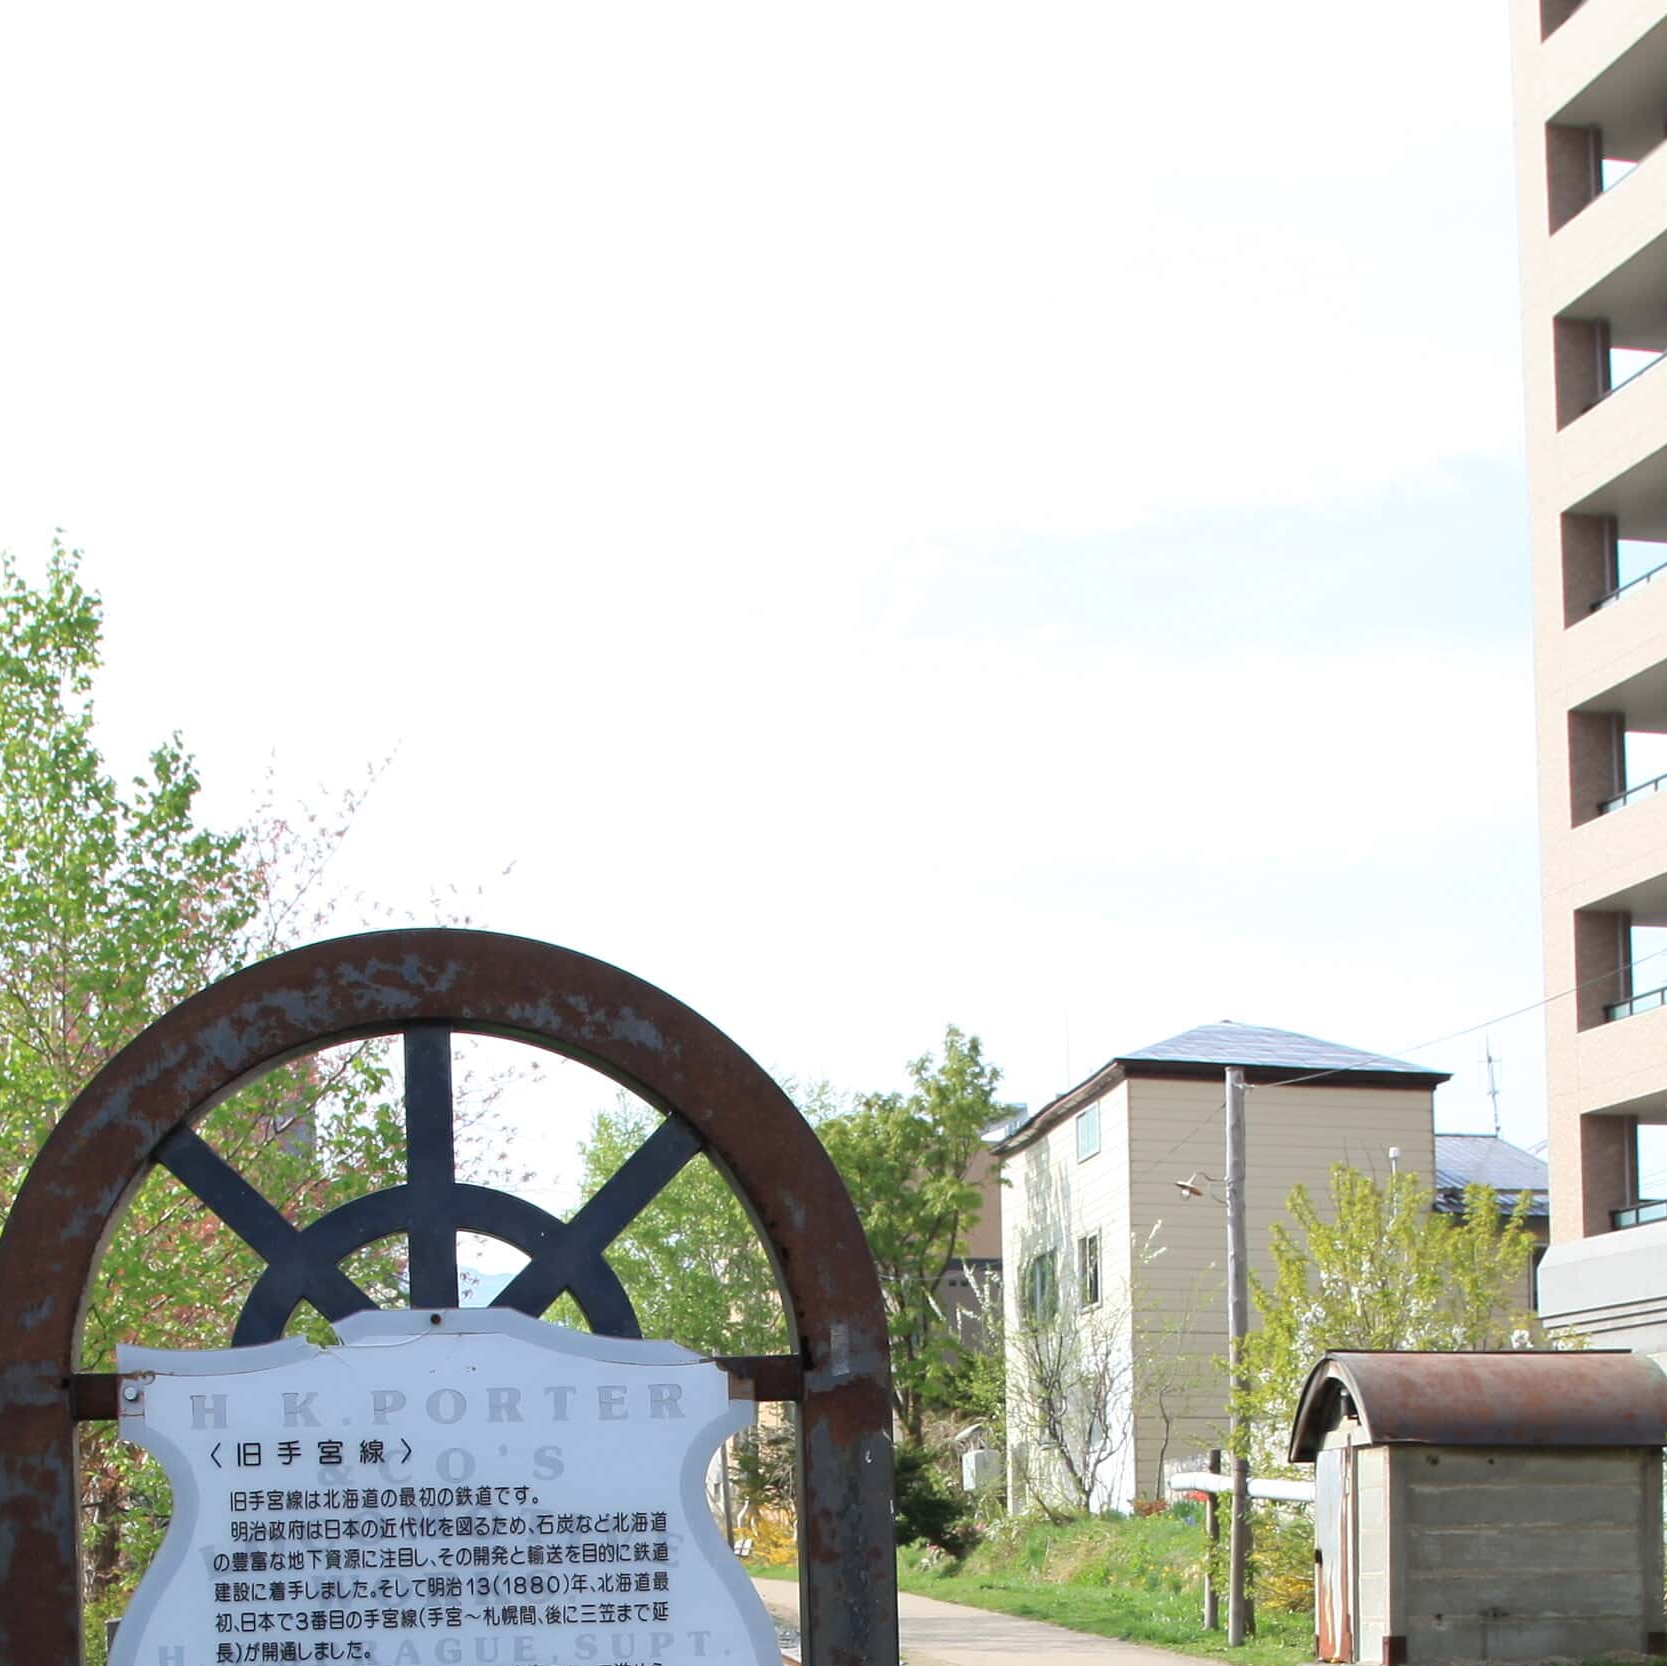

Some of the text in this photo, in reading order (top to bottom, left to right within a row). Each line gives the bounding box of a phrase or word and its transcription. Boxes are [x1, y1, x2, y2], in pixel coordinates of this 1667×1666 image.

[230, 1486, 540, 1512] 旧手宮線は北海道の最初の鉄道です。
[230, 1511, 668, 1543] 明治政府は日本の近代化を図るため、石炭など北海道
[213, 1542, 670, 1572] の豊富な地下資源に注目し、その開発と輸送を目的に鉄道
[216, 1640, 371, 1665] 長)が開通しました。
